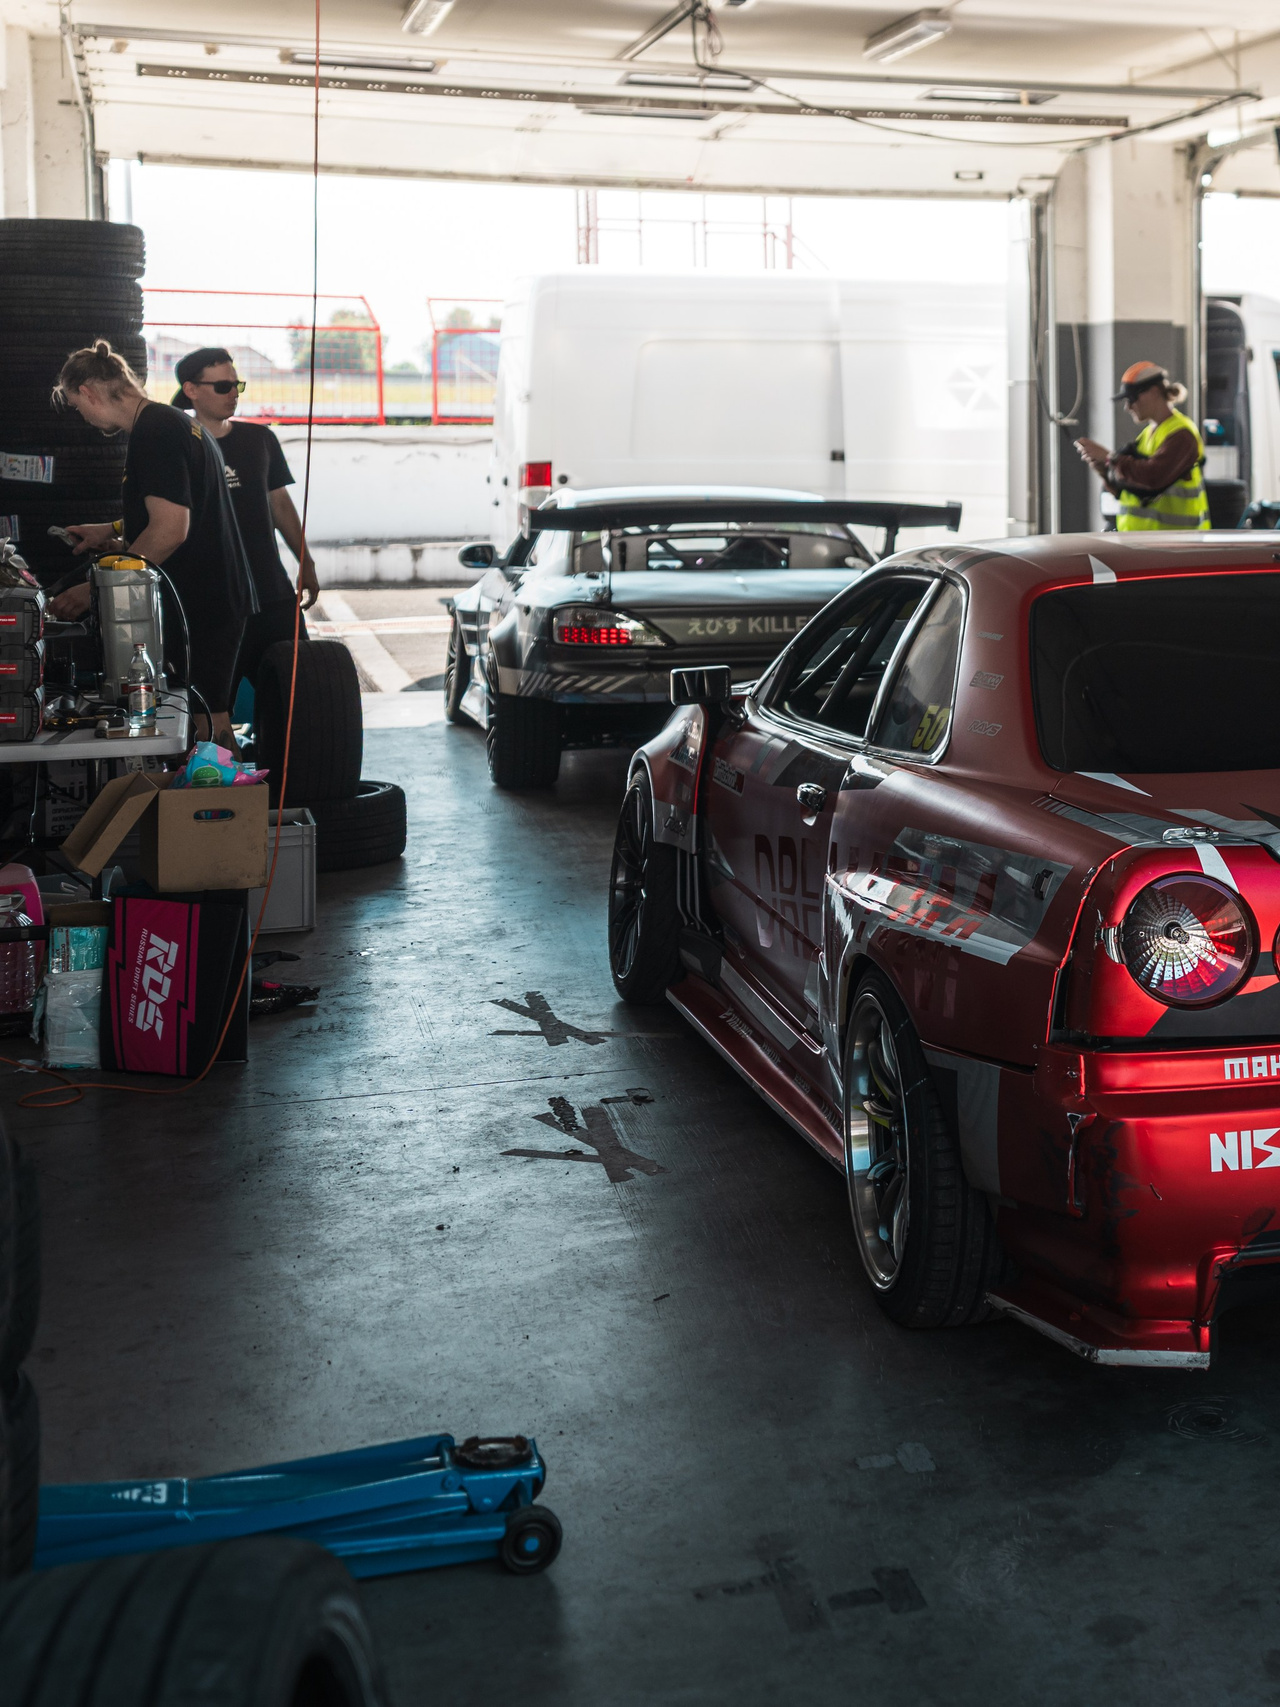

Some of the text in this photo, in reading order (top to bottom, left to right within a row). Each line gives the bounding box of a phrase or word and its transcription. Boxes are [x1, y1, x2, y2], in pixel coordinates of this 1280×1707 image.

[748, 615, 812, 635] KILLE
[911, 704, 951, 752] 50
[127, 927, 149, 1024] RUSSIAN DRIFT SERIES
[135, 932, 180, 1041] RDS
